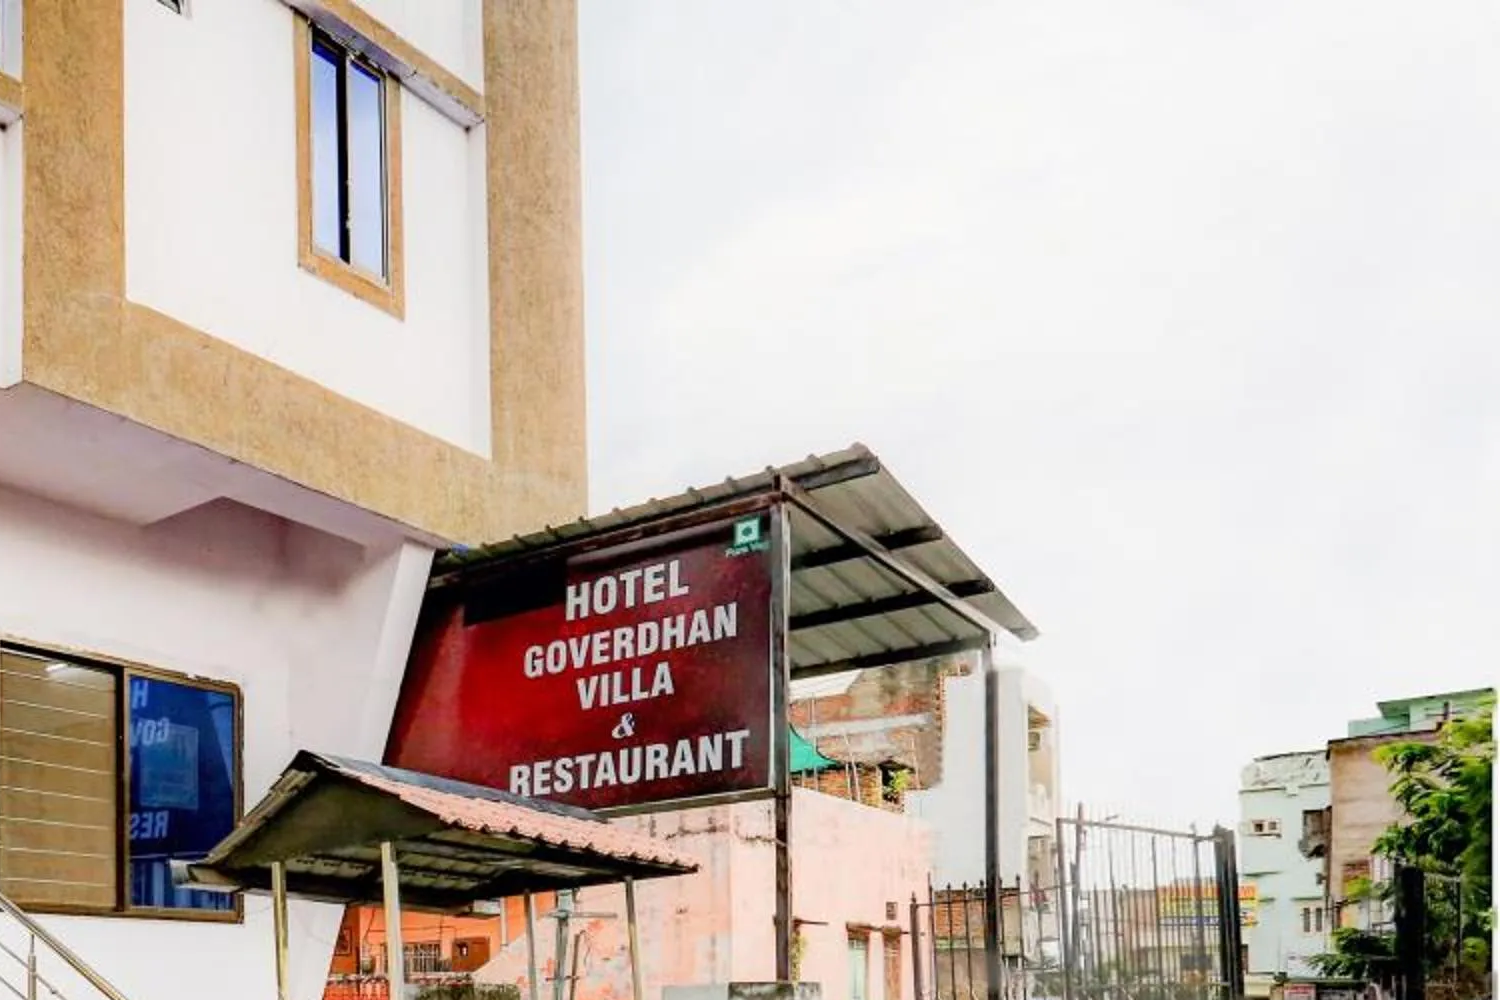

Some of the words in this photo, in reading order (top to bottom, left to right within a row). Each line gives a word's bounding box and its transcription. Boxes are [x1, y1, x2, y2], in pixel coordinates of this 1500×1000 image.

[565, 559, 689, 621] HOTEL
[523, 602, 737, 679] GOVERDHAN
[576, 662, 675, 710] VILLA
[611, 711, 636, 740] &
[509, 729, 751, 799] RESTAURANT
